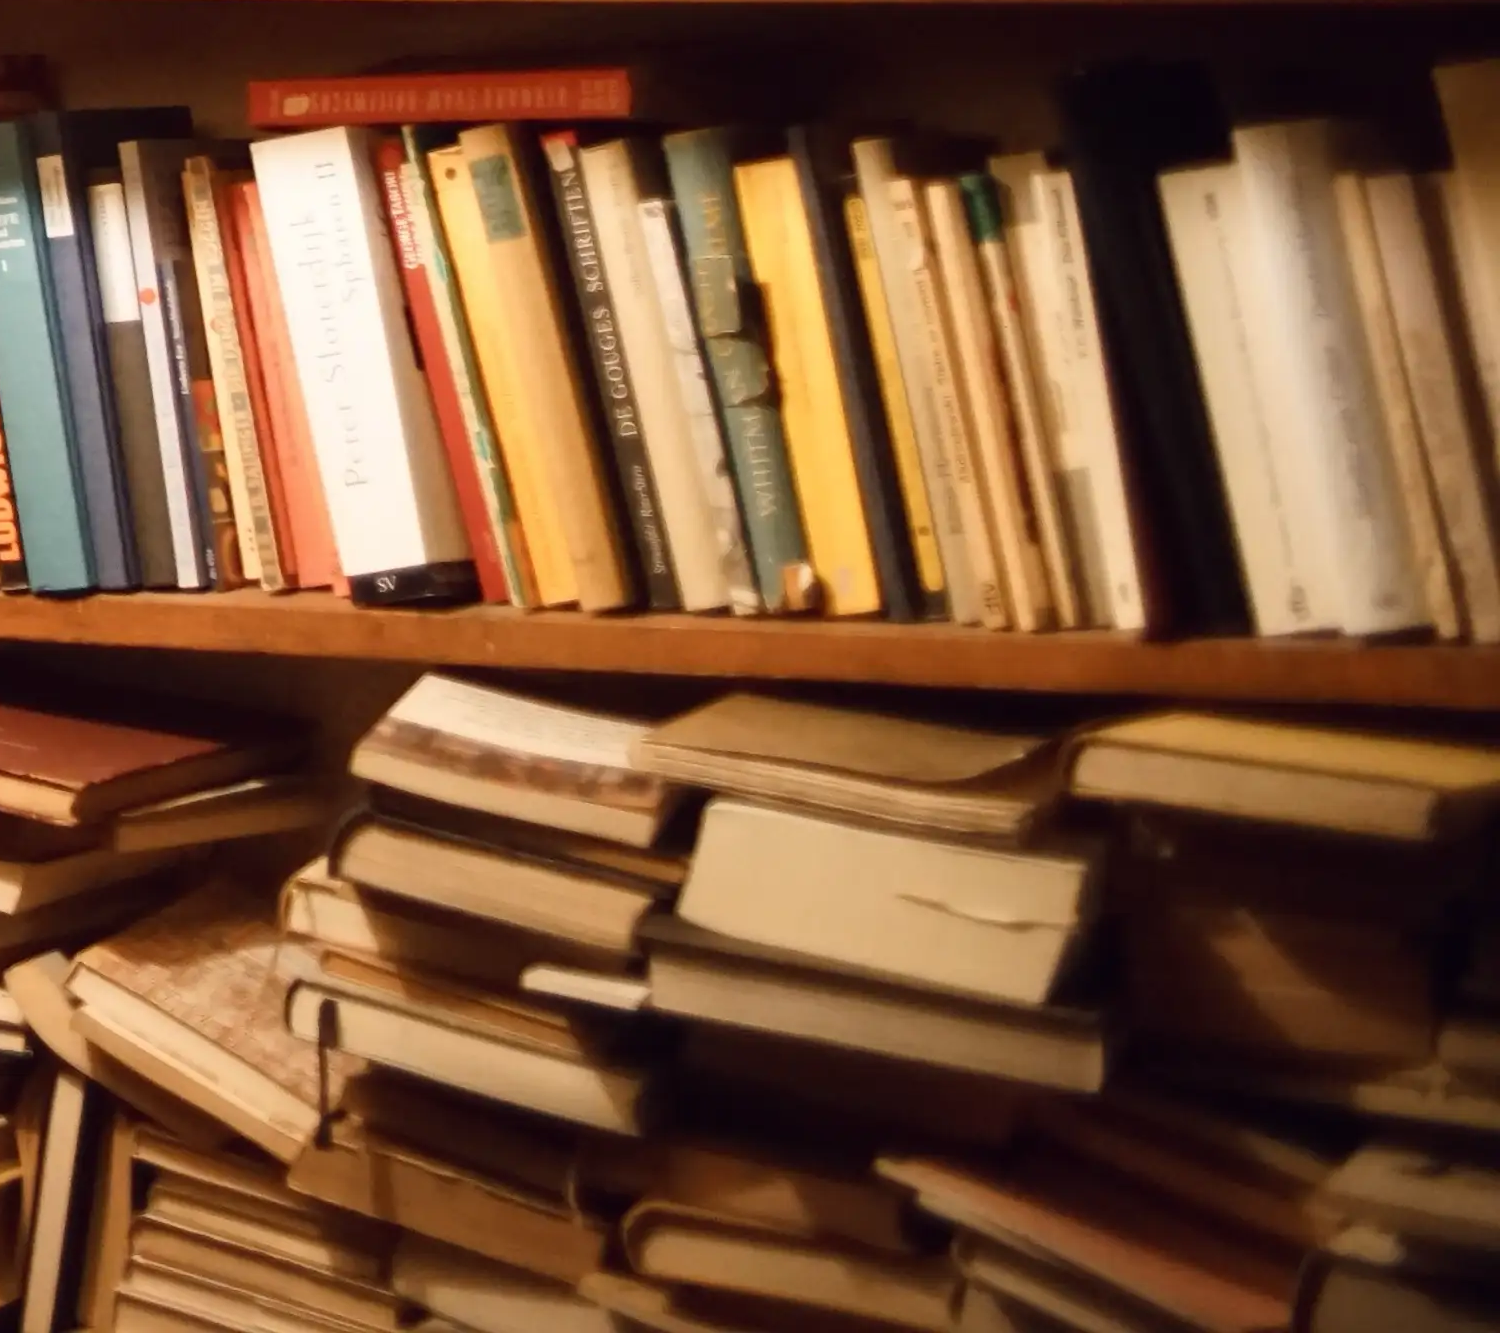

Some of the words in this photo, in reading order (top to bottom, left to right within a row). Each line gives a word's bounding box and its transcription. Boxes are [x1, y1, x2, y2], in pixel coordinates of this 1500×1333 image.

[383, 171, 405, 216] TABORI
[558, 168, 604, 294] SCHRIFTEN
[394, 218, 420, 270] GEORGE
[289, 208, 346, 384] Sloterdijk
[591, 305, 630, 400] GOUGES
[336, 402, 370, 489] Peter
[614, 405, 641, 438] DE
[722, 368, 779, 519] WHITMAN
[376, 575, 397, 593] SV
